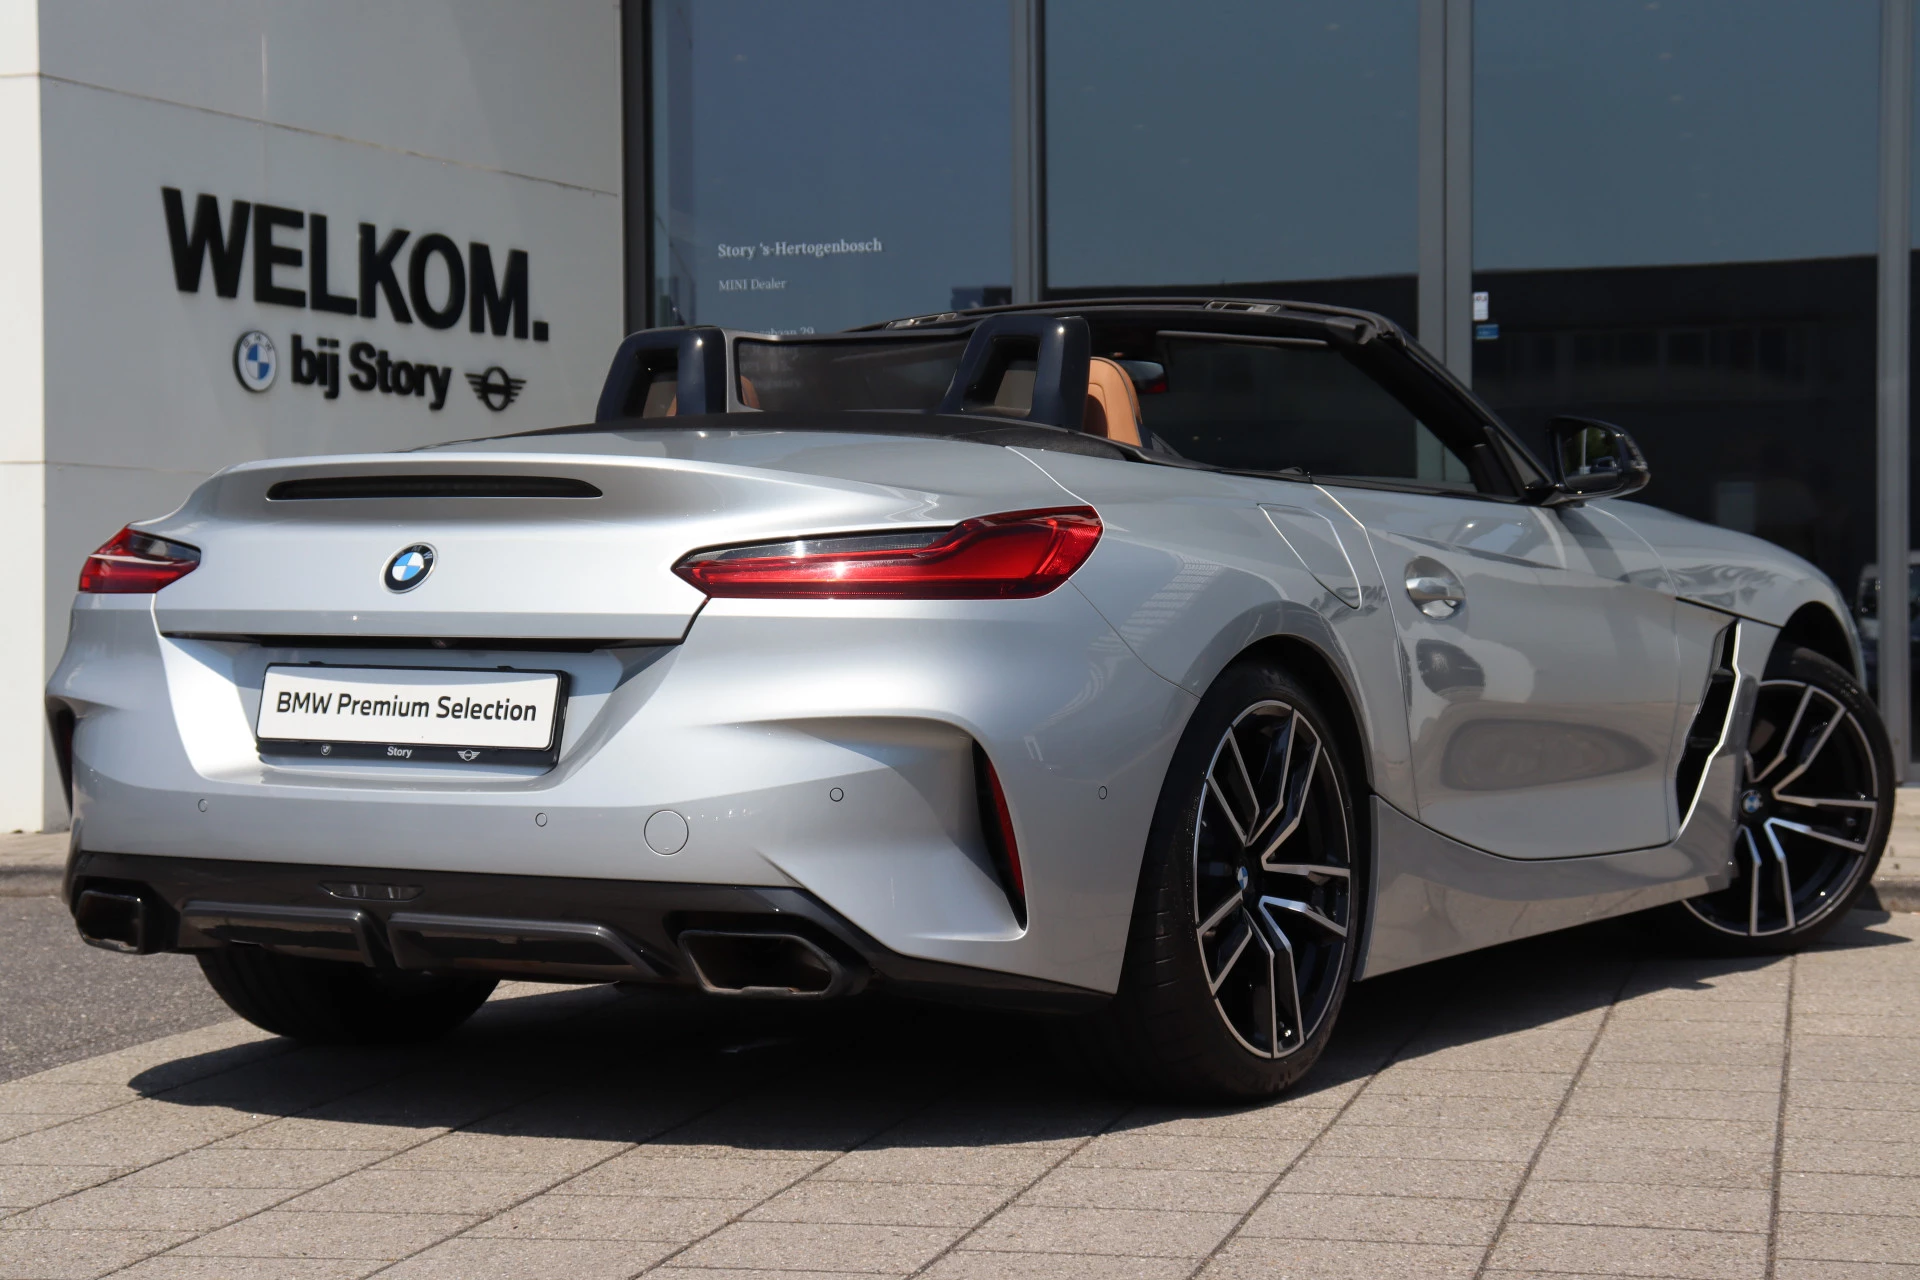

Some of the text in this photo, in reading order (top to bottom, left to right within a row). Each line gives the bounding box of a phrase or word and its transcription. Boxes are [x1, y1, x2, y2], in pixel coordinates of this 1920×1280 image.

[717, 243, 756, 260] Story
[161, 186, 549, 342] WELKOM.
[718, 277, 788, 292] MINI Dealer
[291, 334, 452, 411] bij Story
[276, 690, 538, 722] BMW Premium Selection
[386, 745, 413, 759] Story
